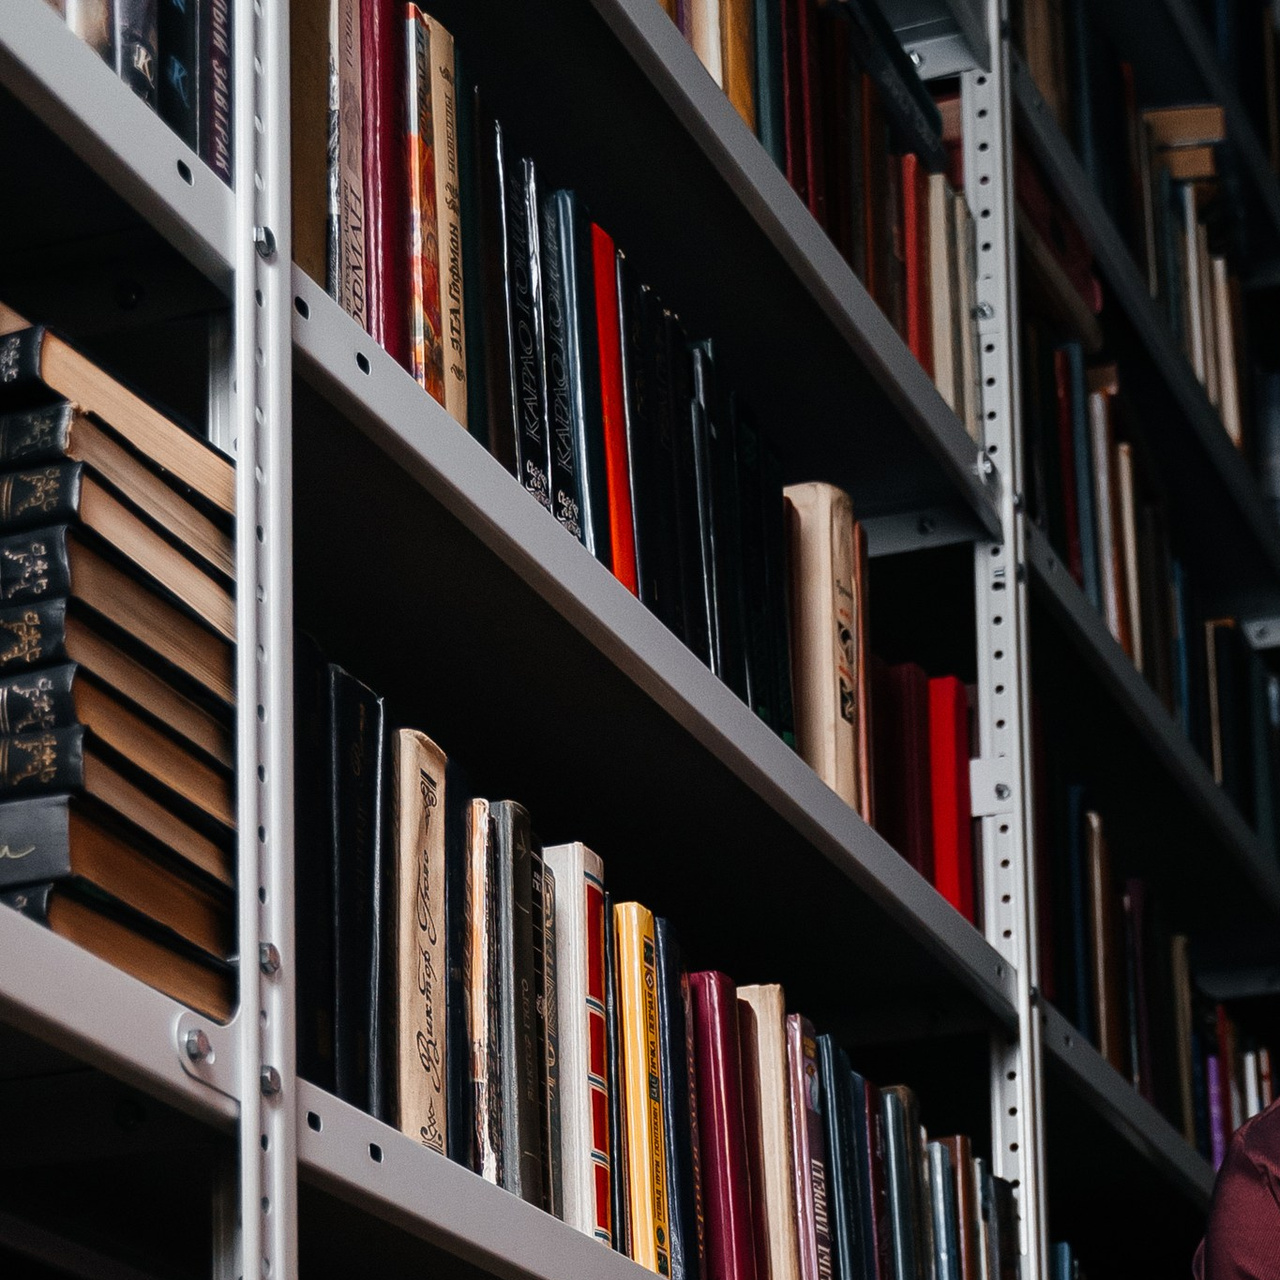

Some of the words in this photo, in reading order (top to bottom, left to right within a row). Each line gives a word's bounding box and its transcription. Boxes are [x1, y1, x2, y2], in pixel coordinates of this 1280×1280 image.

[212, 58, 232, 177] ЗАВТРАК
[448, 222, 462, 304] Гофман
[517, 320, 541, 443] КАРЛО
[550, 352, 573, 476] КАРЛО
[416, 849, 437, 945] Гюго
[416, 948, 441, 1094] Виктор
